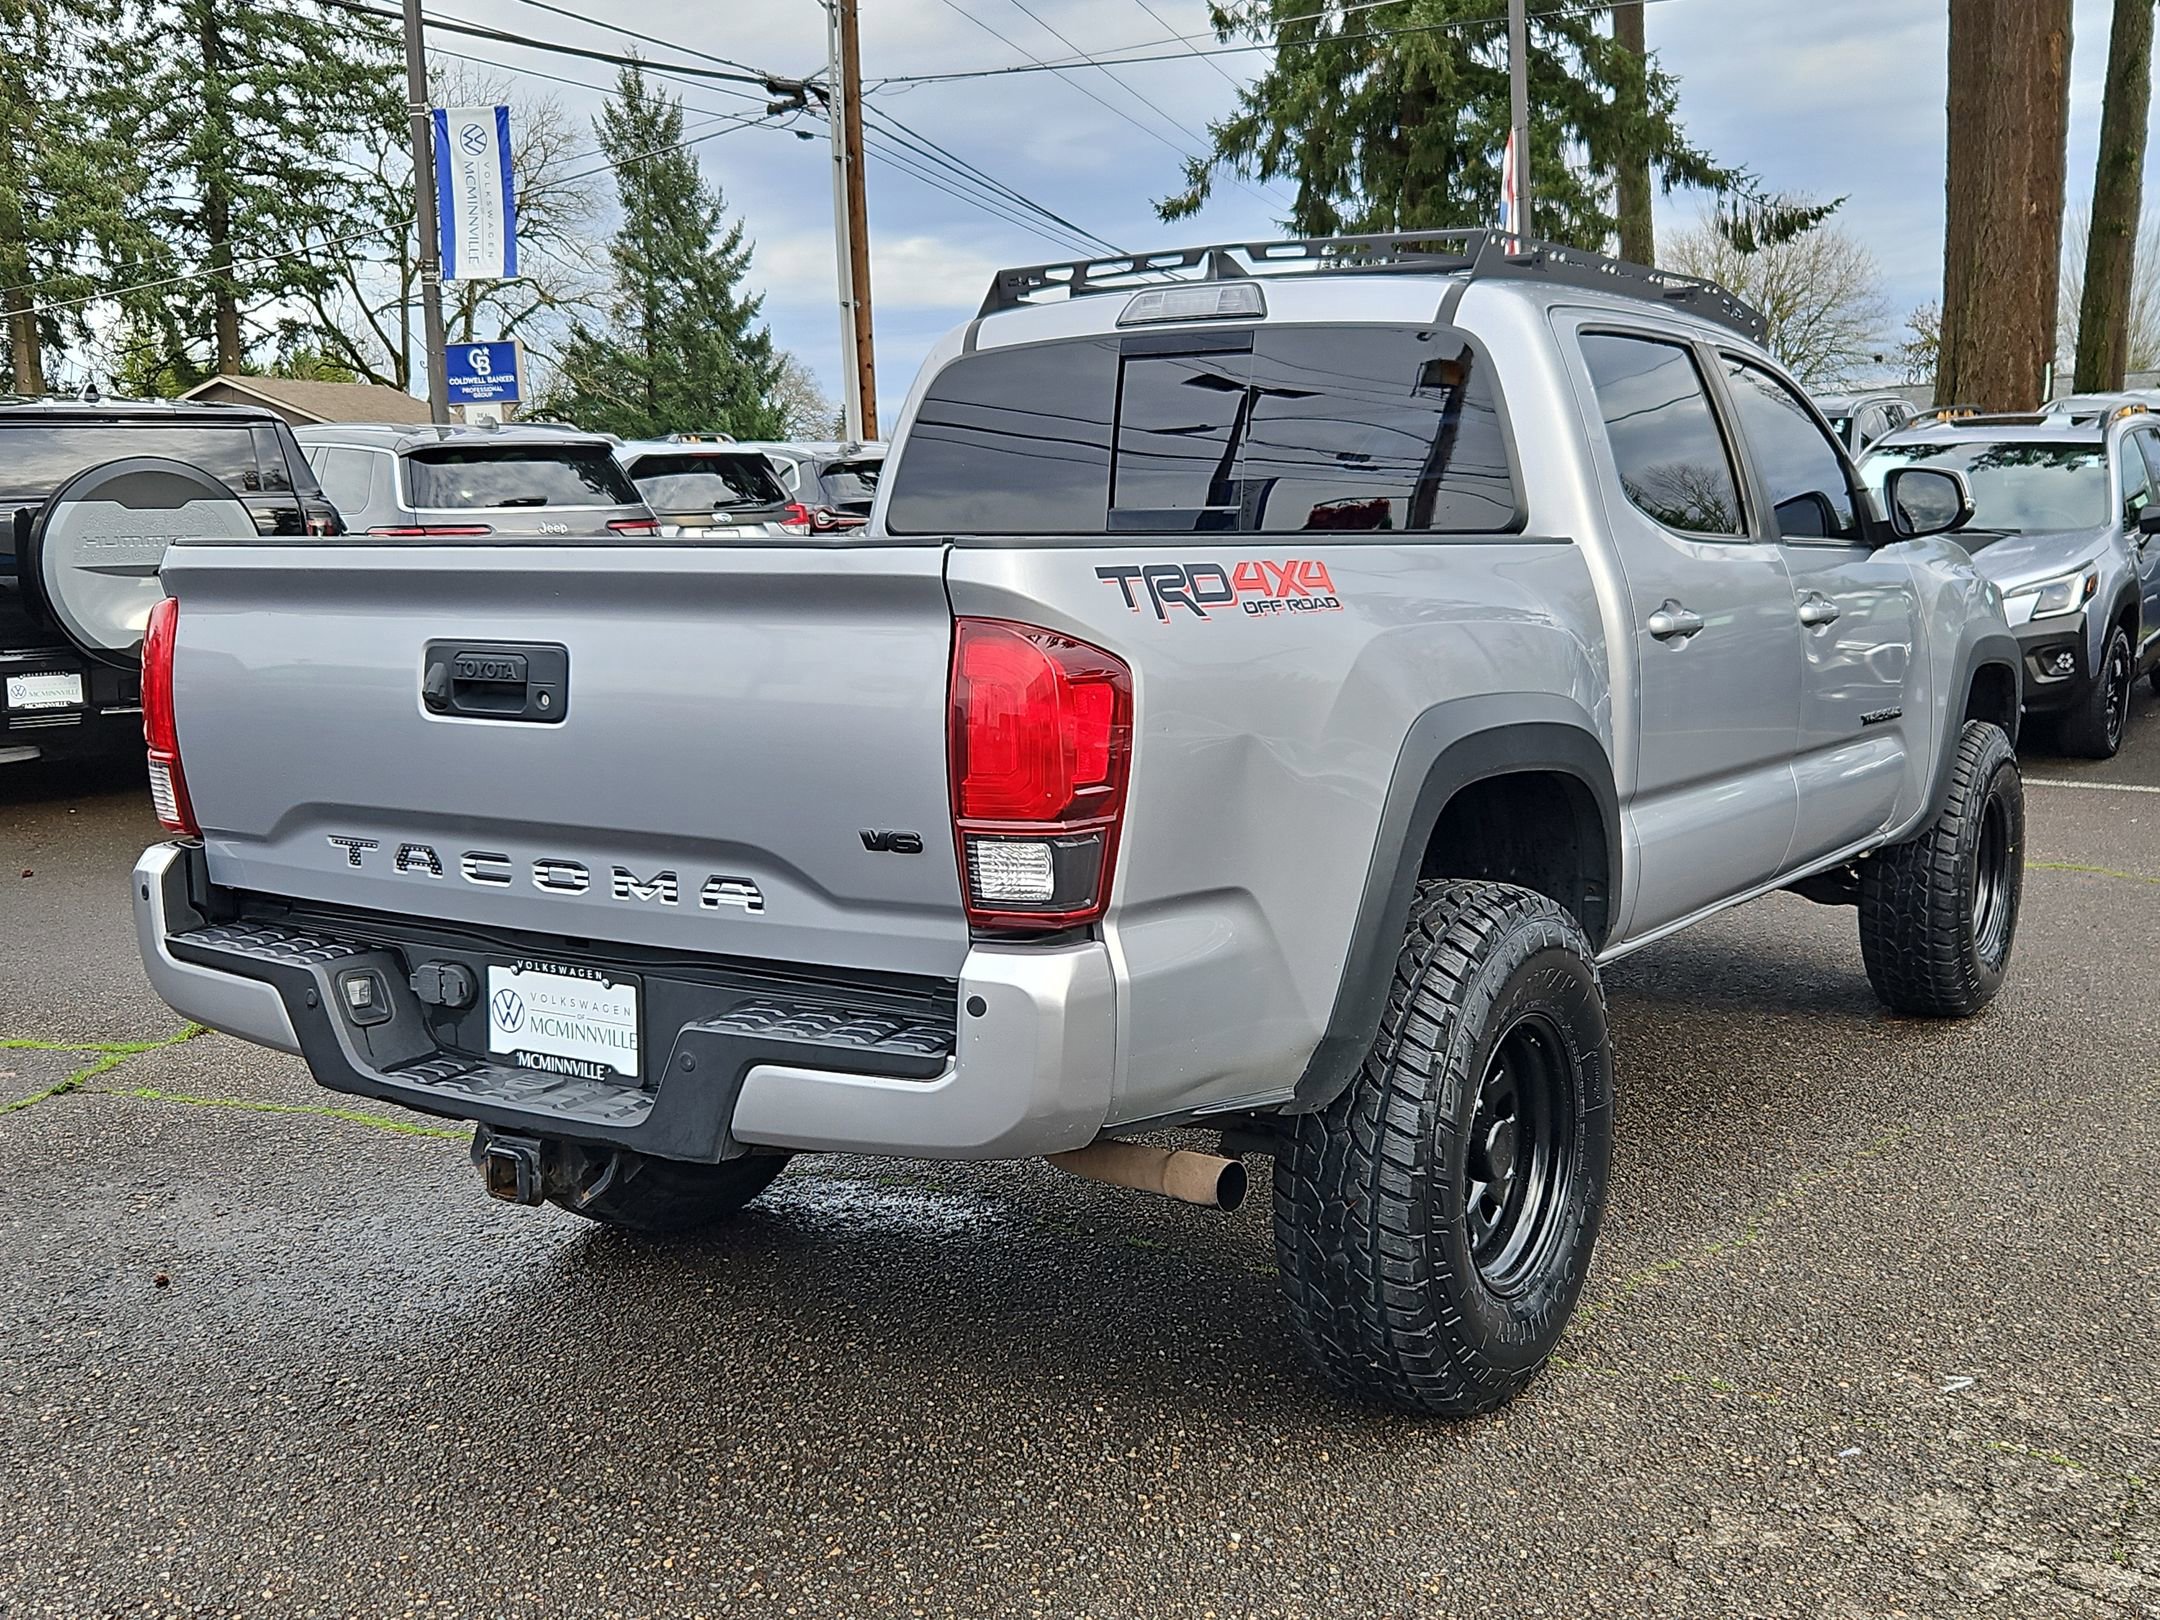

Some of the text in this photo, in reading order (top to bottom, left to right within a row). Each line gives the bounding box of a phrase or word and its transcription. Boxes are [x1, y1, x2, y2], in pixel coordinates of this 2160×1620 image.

[464, 161, 480, 264] MCMINNVILLE
[483, 161, 495, 258] VOLKSWAGEN
[448, 375, 515, 386] COLDWELL BANKER
[538, 521, 569, 536] Jeep
[1094, 560, 1336, 624] TRD 4X4
[1242, 596, 1344, 617] OFF ROAD
[455, 660, 518, 680] TOYOTA
[858, 828, 924, 855] V6
[327, 834, 767, 915] TACOMA
[517, 960, 603, 980] VOLKSWAGEN
[530, 992, 632, 1017] VOLKSWAGEN
[576, 1013, 586, 1021] OF
[530, 1016, 639, 1051] MCMINNVILLE
[517, 1051, 606, 1081] MCMINNVILLE
